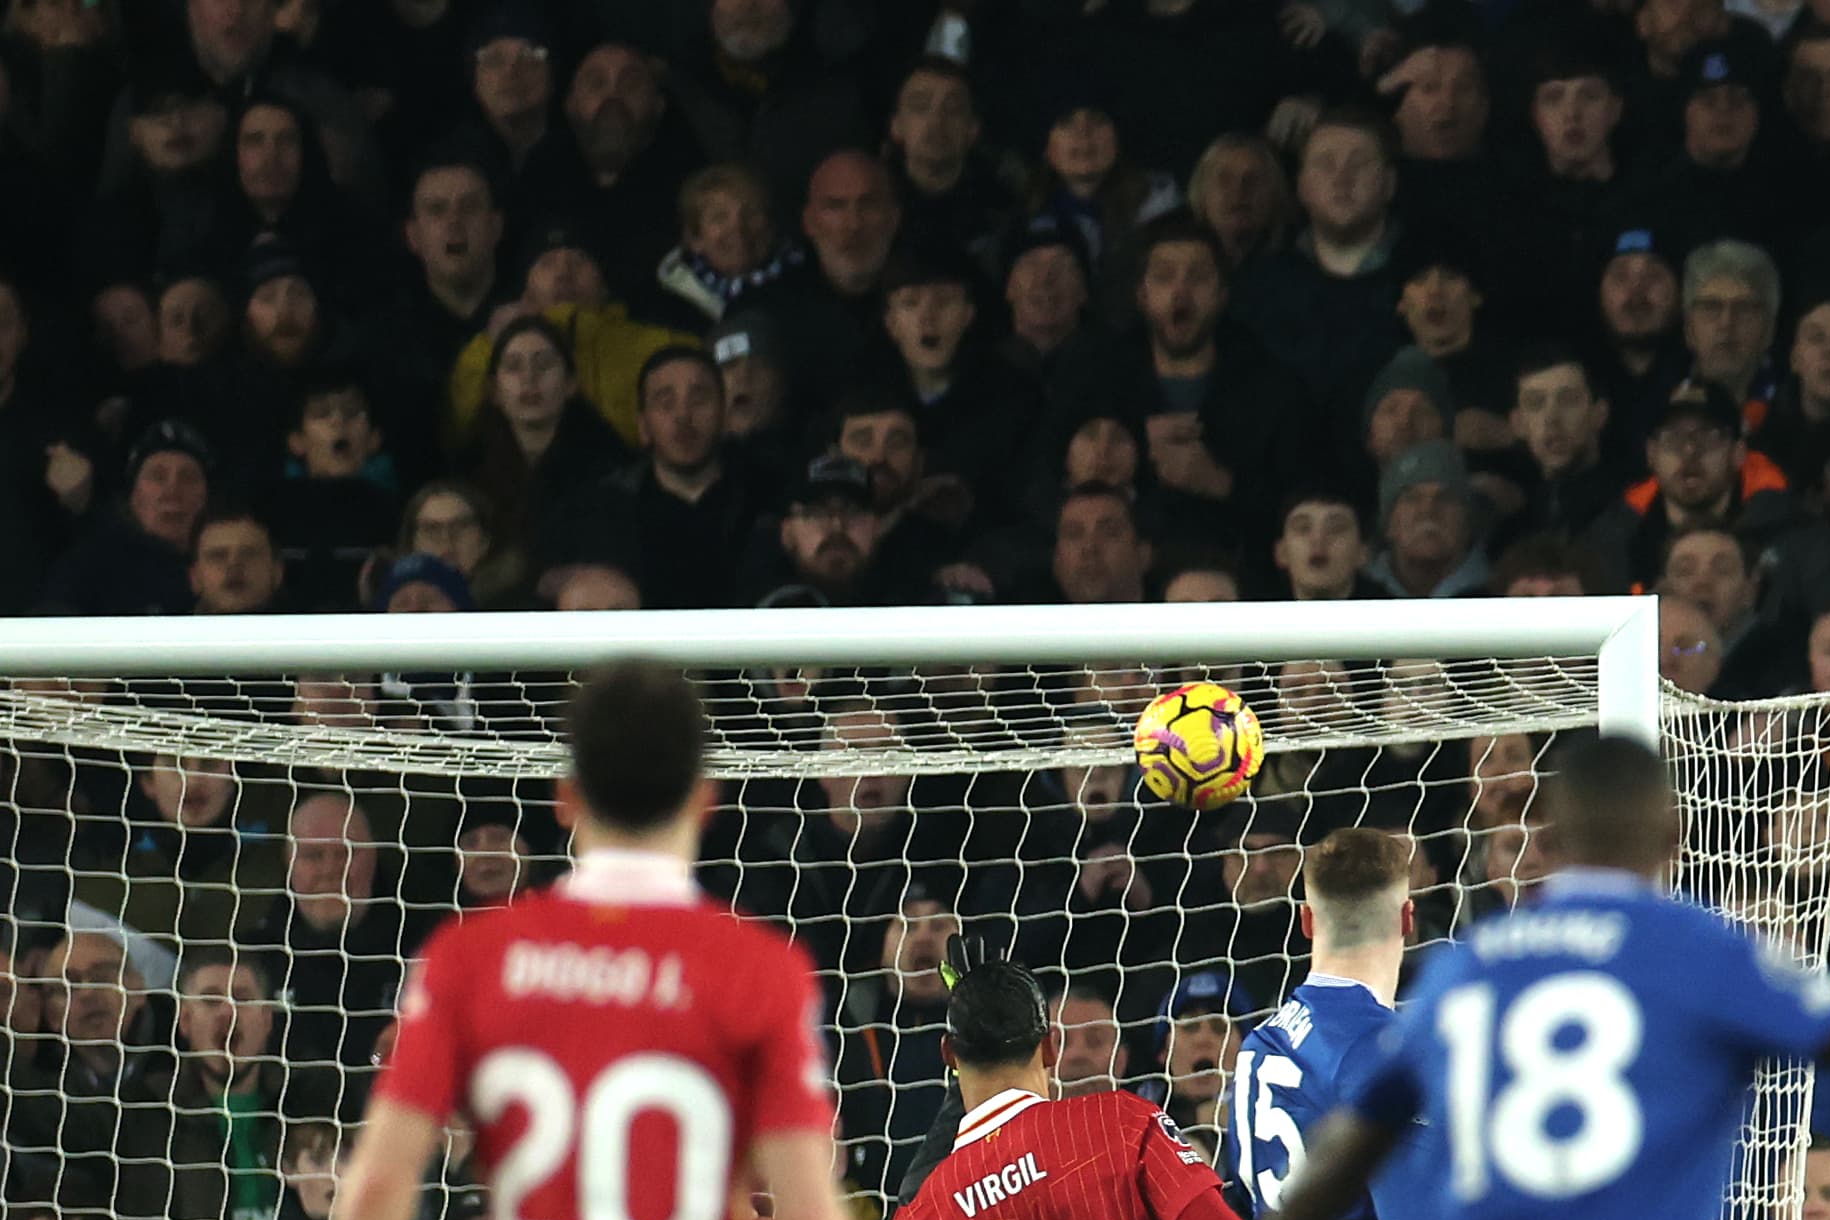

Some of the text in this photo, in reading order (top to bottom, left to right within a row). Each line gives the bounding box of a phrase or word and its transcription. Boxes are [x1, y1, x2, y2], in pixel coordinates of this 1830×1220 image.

[1233, 1049, 1308, 1212] 15
[1436, 971, 1644, 1201] 18
[953, 1152, 1048, 1218] VIRGIL
